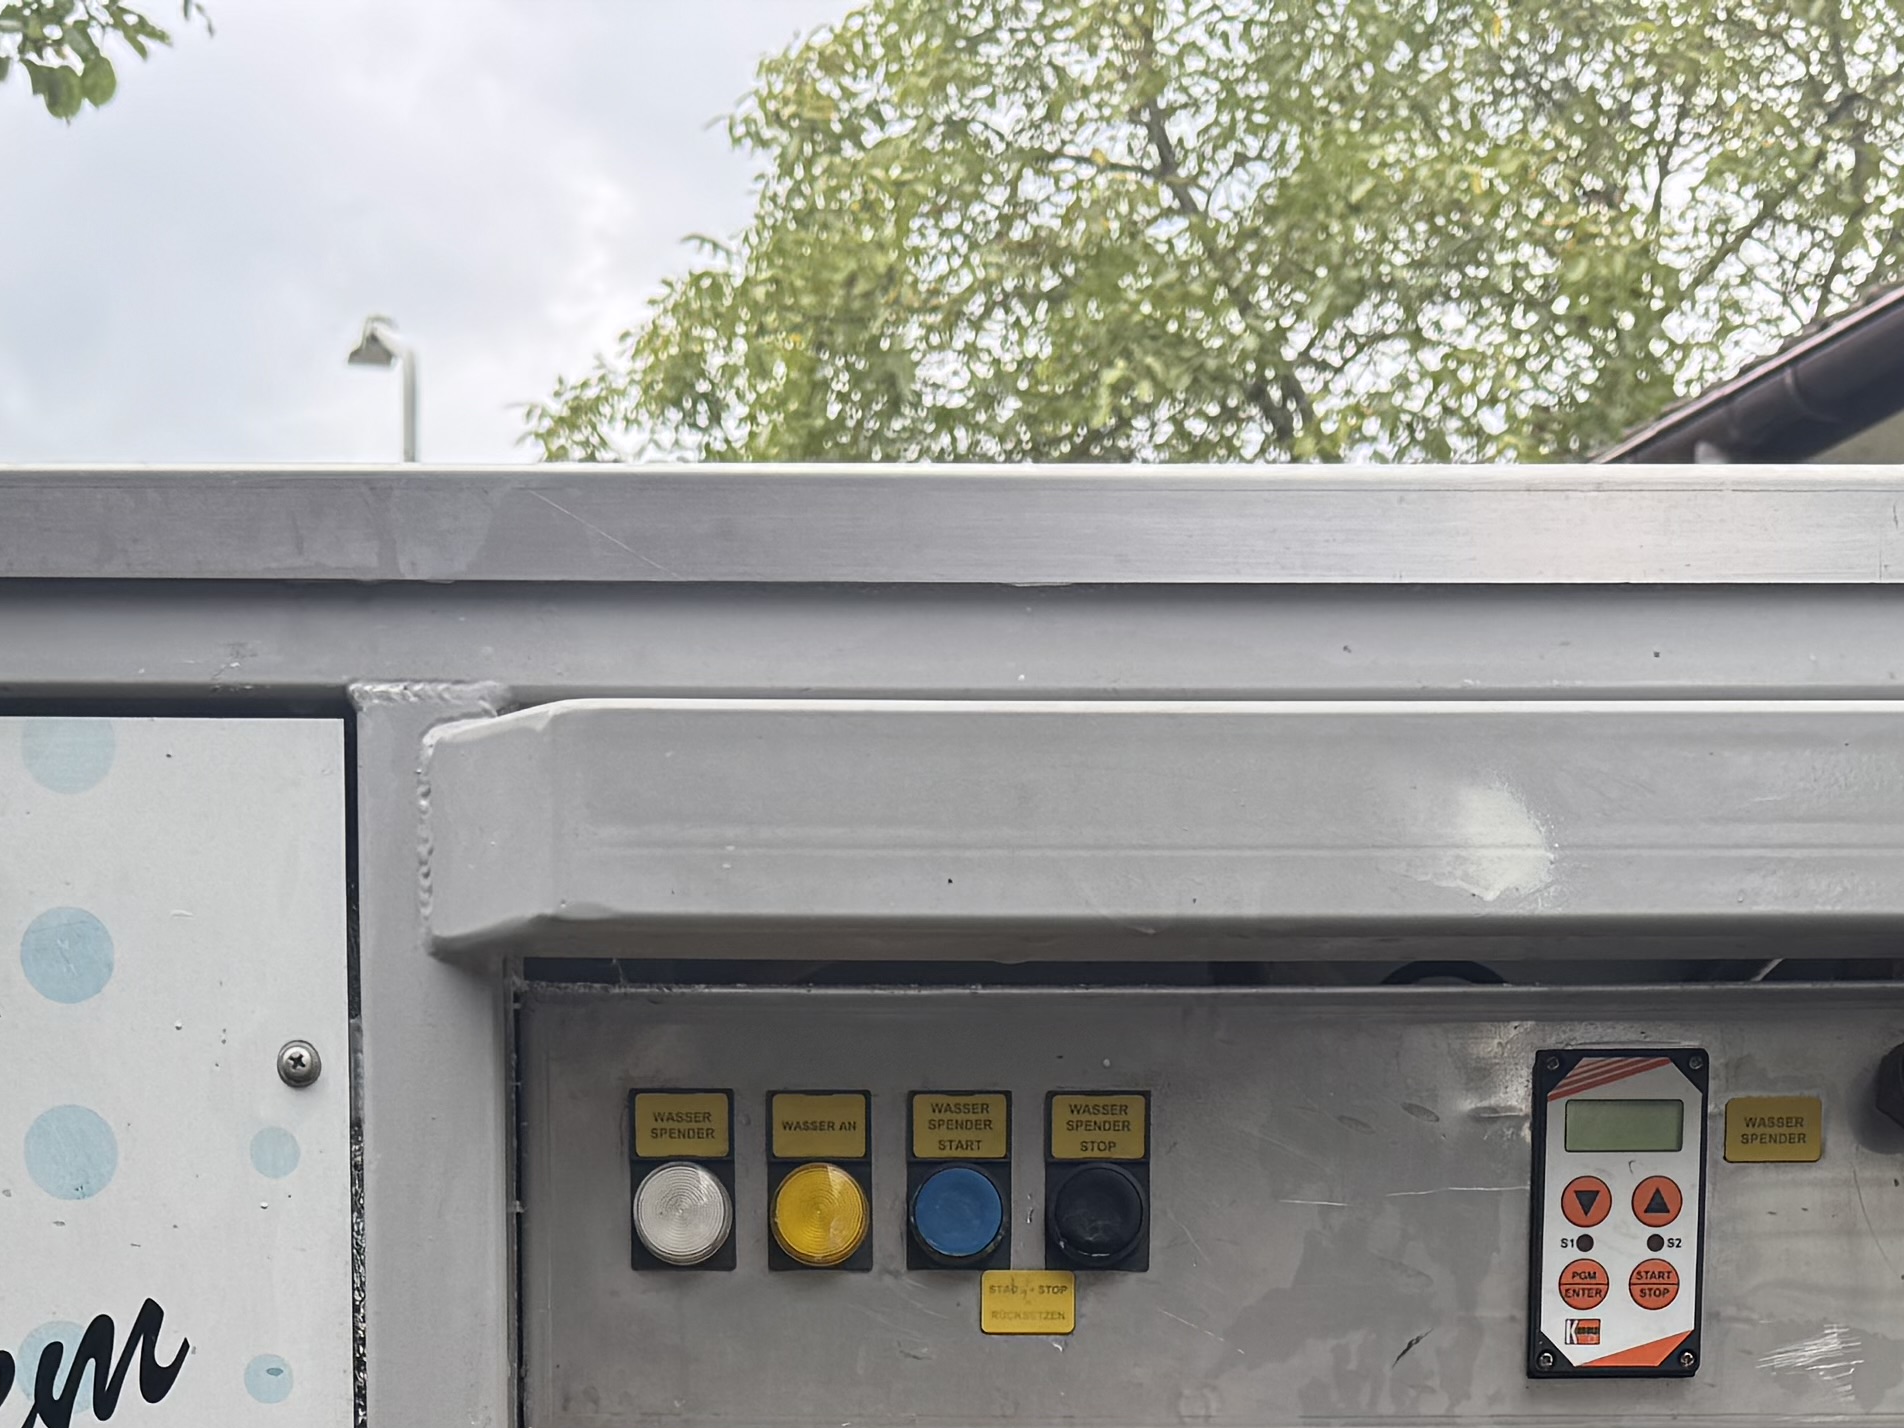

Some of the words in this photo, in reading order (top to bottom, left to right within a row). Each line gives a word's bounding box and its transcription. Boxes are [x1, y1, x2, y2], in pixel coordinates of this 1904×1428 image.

[931, 1102, 990, 1115] WASSER
[1069, 1103, 1129, 1117] WASSER
[653, 1111, 712, 1124] WASSER
[1744, 1116, 1805, 1129] WASSER
[782, 1120, 835, 1132] WASSER
[839, 1120, 857, 1132] AN
[927, 1118, 993, 1131] SPENDER
[1066, 1119, 1132, 1133] SPENDER
[650, 1127, 716, 1140] SPENDER
[1740, 1132, 1807, 1145] SPENDER
[937, 1138, 982, 1151] START
[1080, 1140, 1117, 1152] STOP
[1560, 1237, 1574, 1249] S1
[1666, 1237, 1682, 1248] S2
[1571, 1270, 1598, 1280] PGM
[1636, 1270, 1673, 1281] START
[1038, 1285, 1069, 1295] STOP
[1564, 1287, 1603, 1299] ENTER
[1639, 1287, 1671, 1298] STOP
